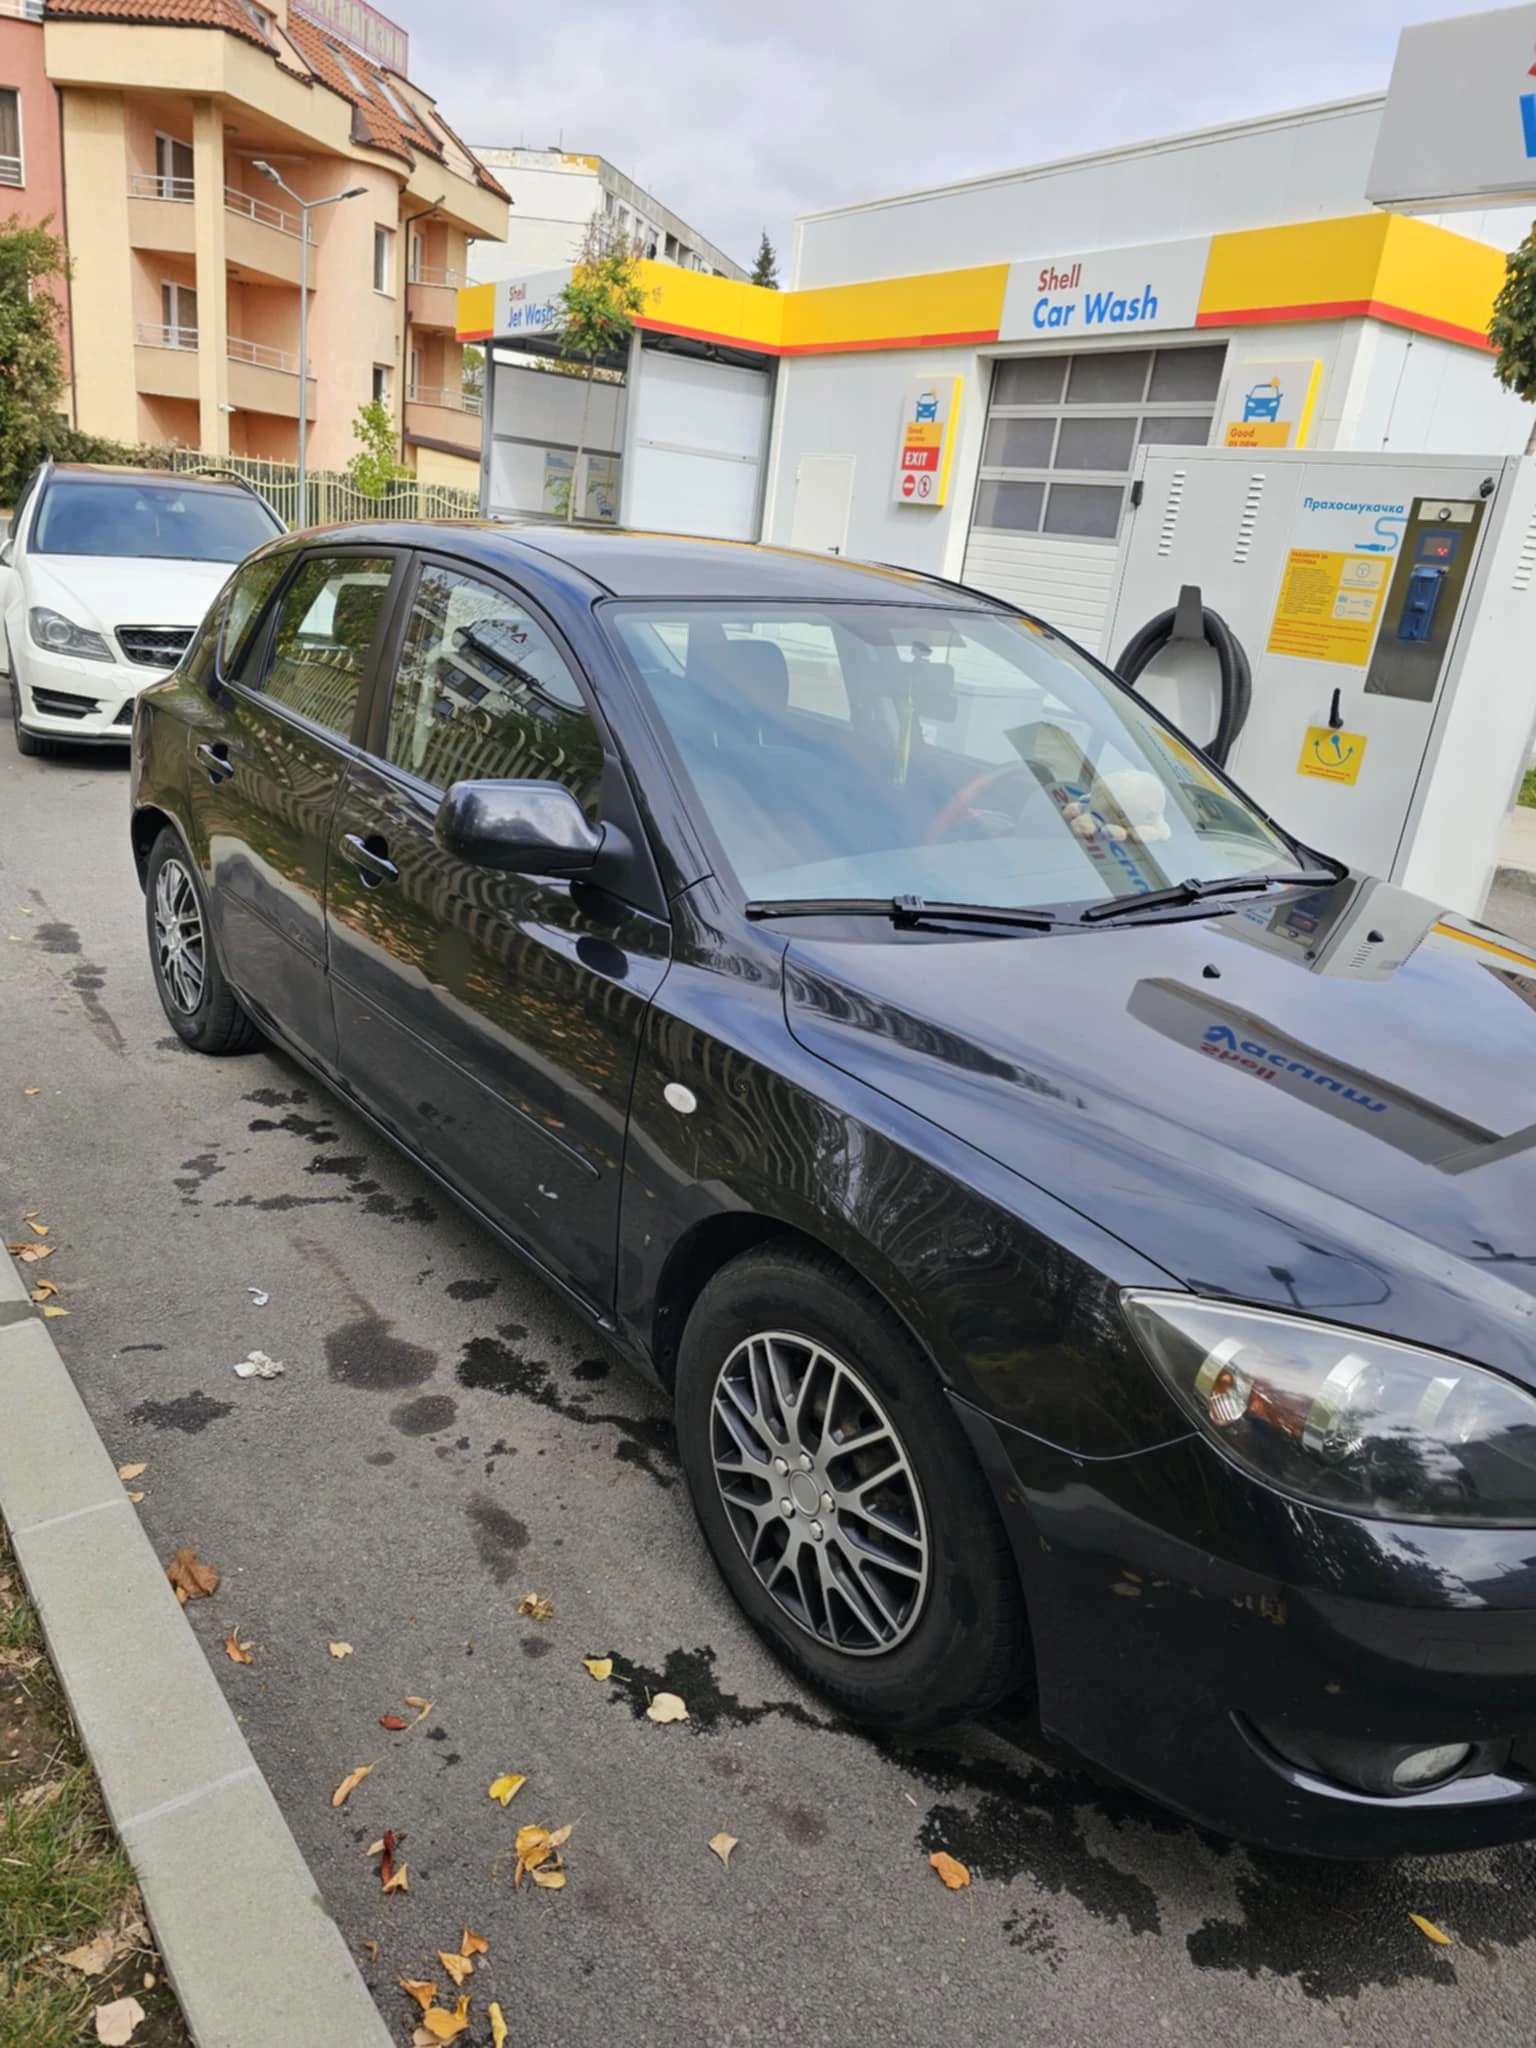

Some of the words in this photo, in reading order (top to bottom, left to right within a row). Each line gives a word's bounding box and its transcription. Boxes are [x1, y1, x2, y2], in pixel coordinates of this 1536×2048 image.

[1037, 263, 1082, 292] Shell
[509, 283, 527, 302] Shell
[1032, 297, 1076, 329] Car
[1084, 284, 1158, 325] Wash
[508, 306, 522, 328] Jet
[1230, 427, 1256, 438] Good
[904, 451, 929, 466] EXIT
[1303, 496, 1405, 515] Прахосмукачка
